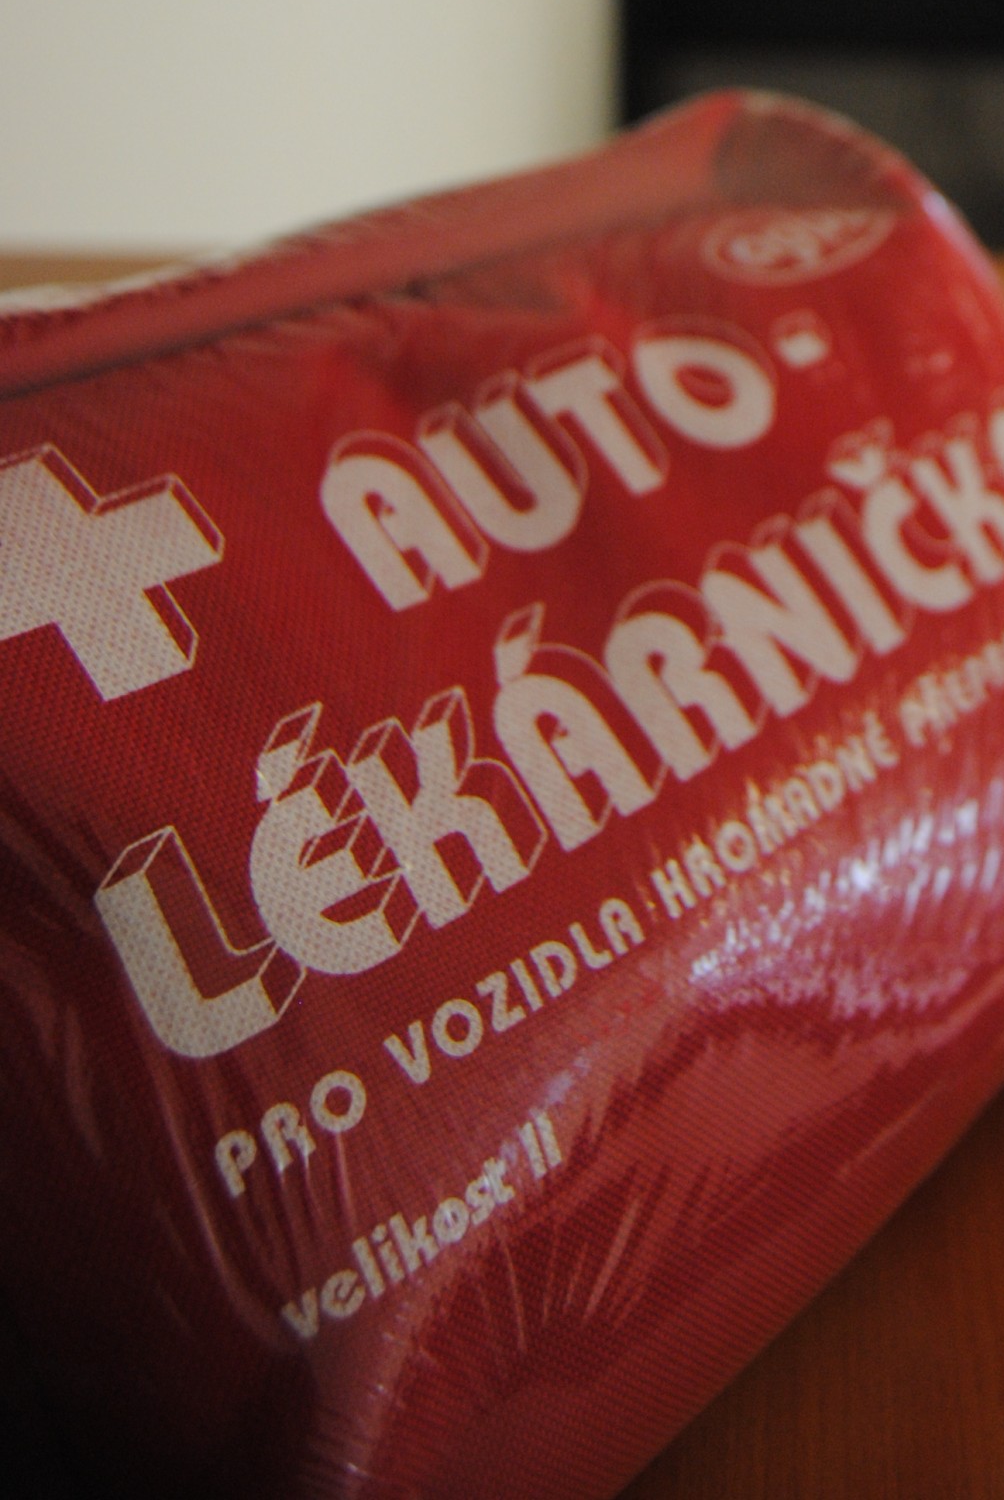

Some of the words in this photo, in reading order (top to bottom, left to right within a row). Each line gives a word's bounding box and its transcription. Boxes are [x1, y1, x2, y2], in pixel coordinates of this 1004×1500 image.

[214, 1069, 367, 1198] PRO
[383, 897, 645, 1083] VOZIDLA
[282, 1157, 515, 1340] velikost
